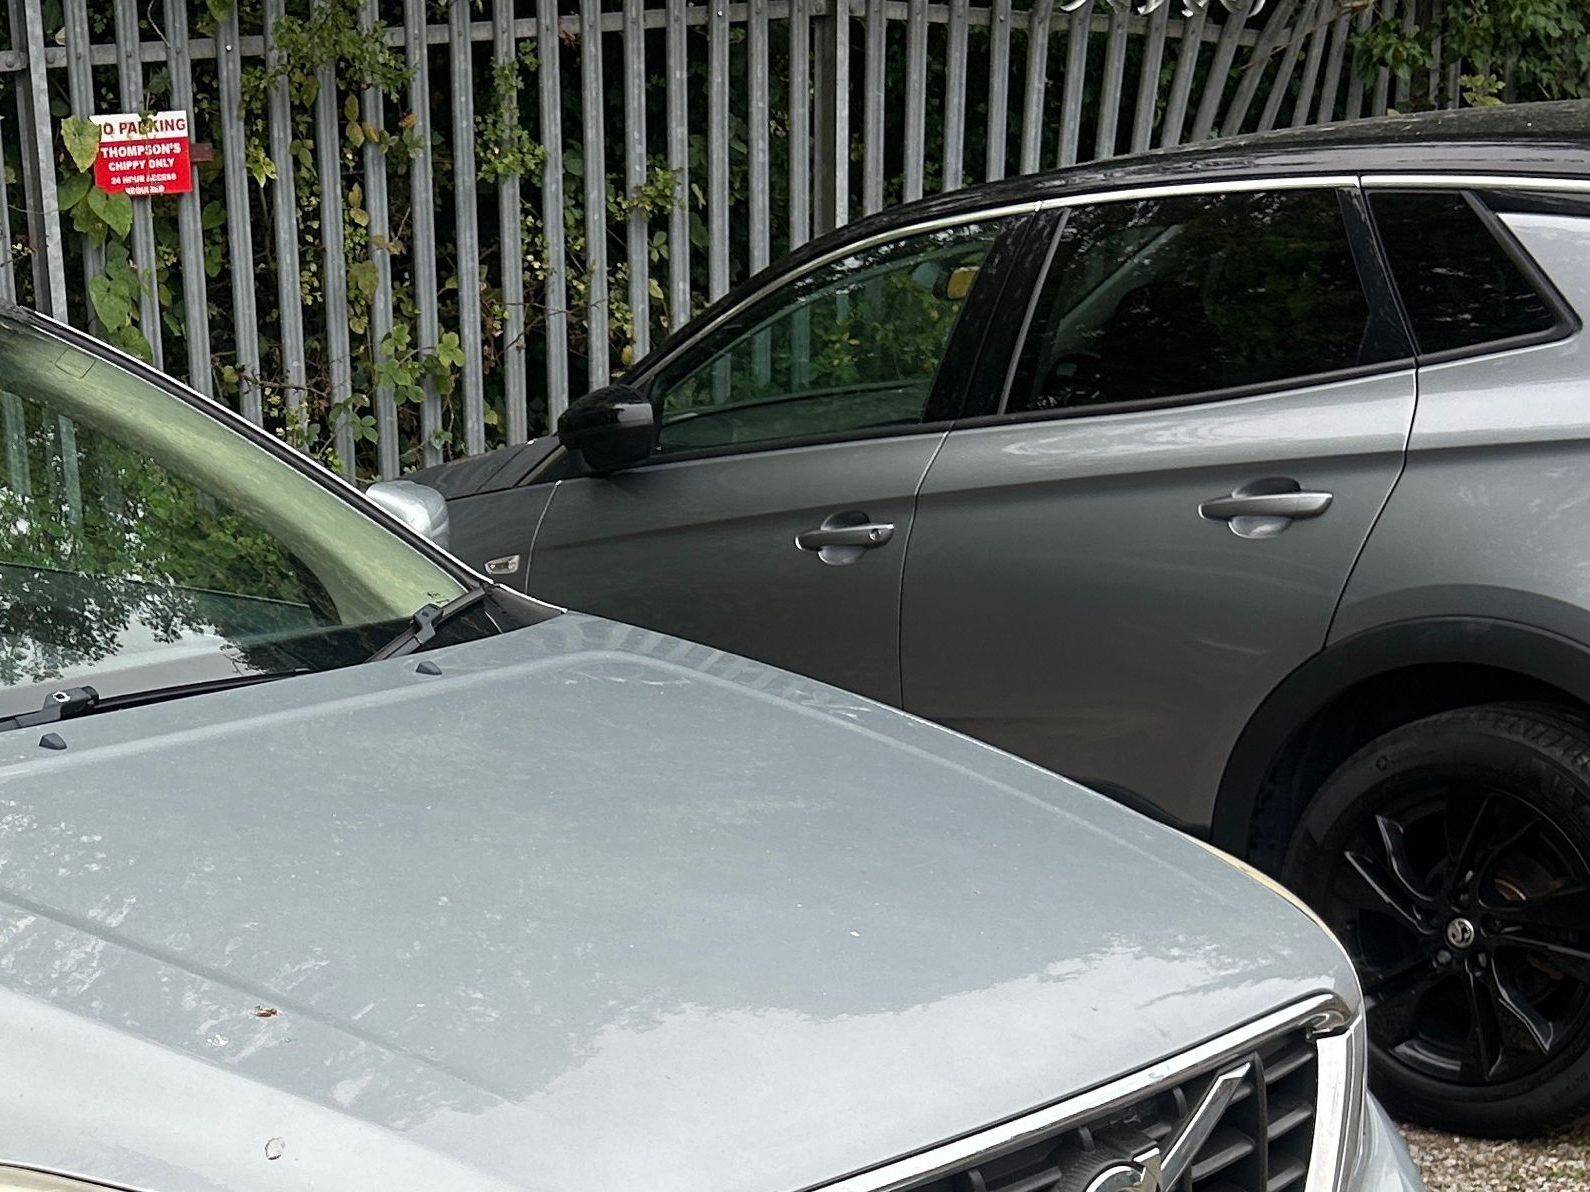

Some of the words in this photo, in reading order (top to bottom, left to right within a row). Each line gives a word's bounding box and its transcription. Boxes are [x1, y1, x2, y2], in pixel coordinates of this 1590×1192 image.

[100, 142, 182, 159] THOMPSON'S
[108, 159, 147, 172] CHIPPY
[148, 158, 175, 169] ONLY
[122, 174, 145, 184] HOUR
[146, 172, 177, 183] ACCESS
